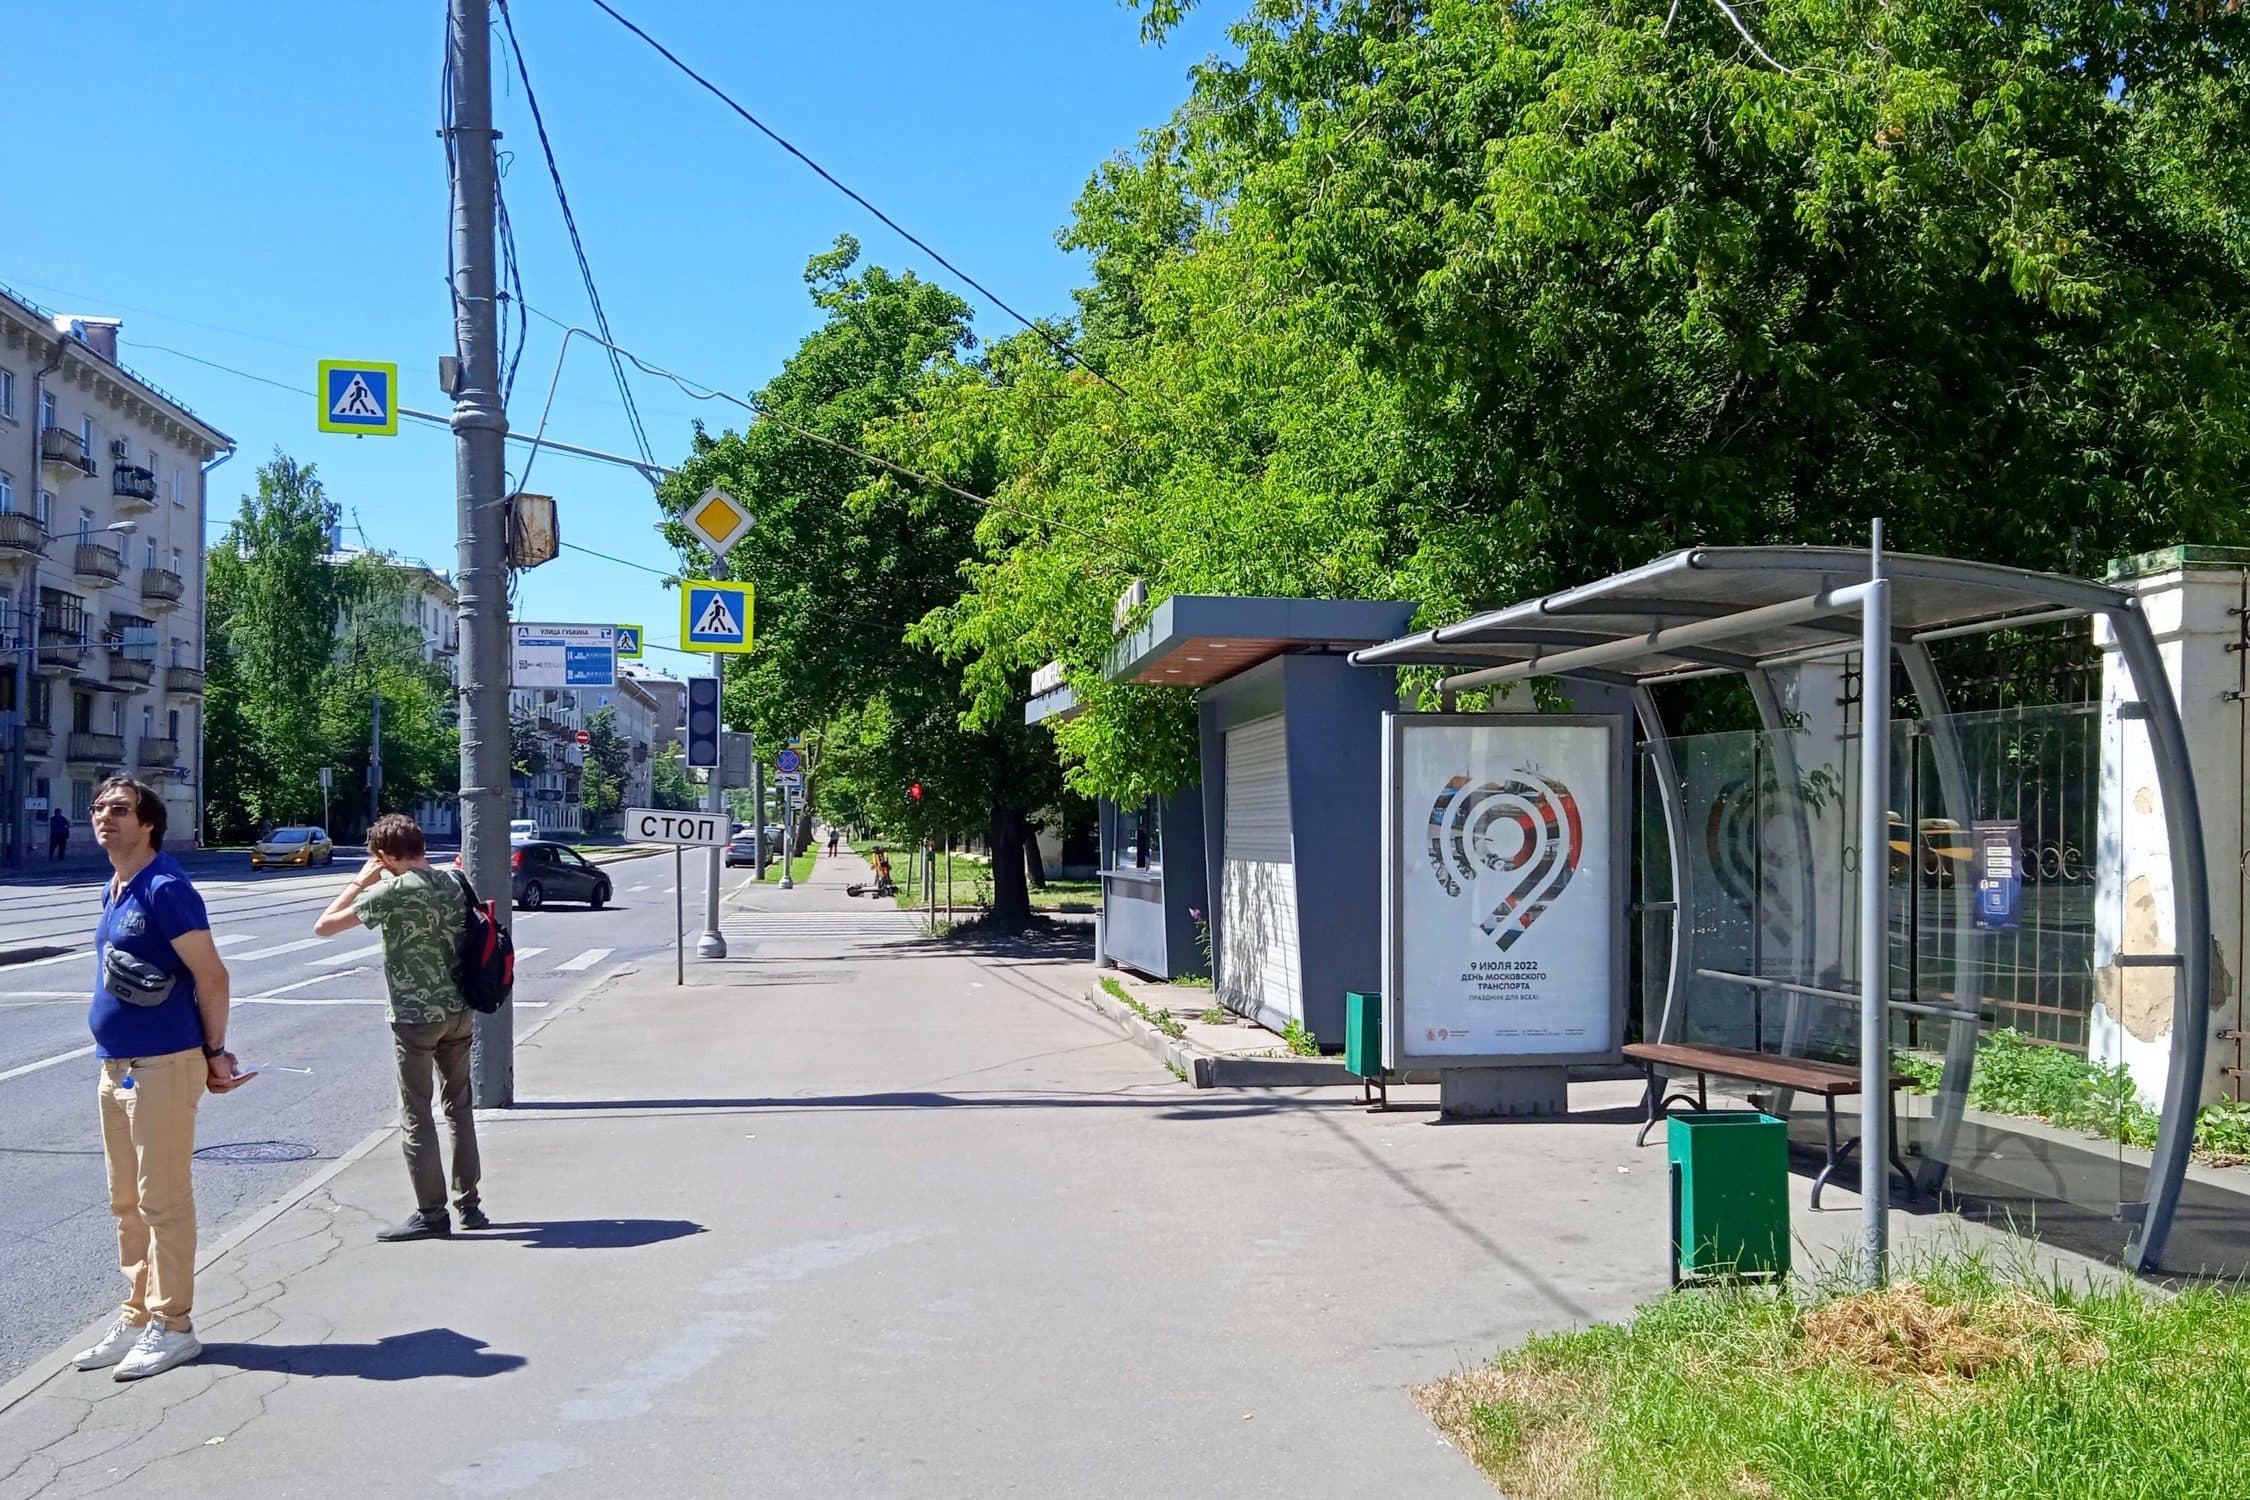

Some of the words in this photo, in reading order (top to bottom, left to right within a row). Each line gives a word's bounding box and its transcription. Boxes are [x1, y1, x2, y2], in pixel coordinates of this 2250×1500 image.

[641, 816, 714, 840] СТОП
[1471, 962, 1477, 971] 9
[1479, 961, 1512, 971] ИЮЛЯ
[1514, 961, 1538, 970] 2022
[1461, 973, 1484, 982] ДЕНЬ
[1485, 972, 1547, 981] МОСКОВСКОГО
[1477, 982, 1531, 990] ТРАНСПОРТА
